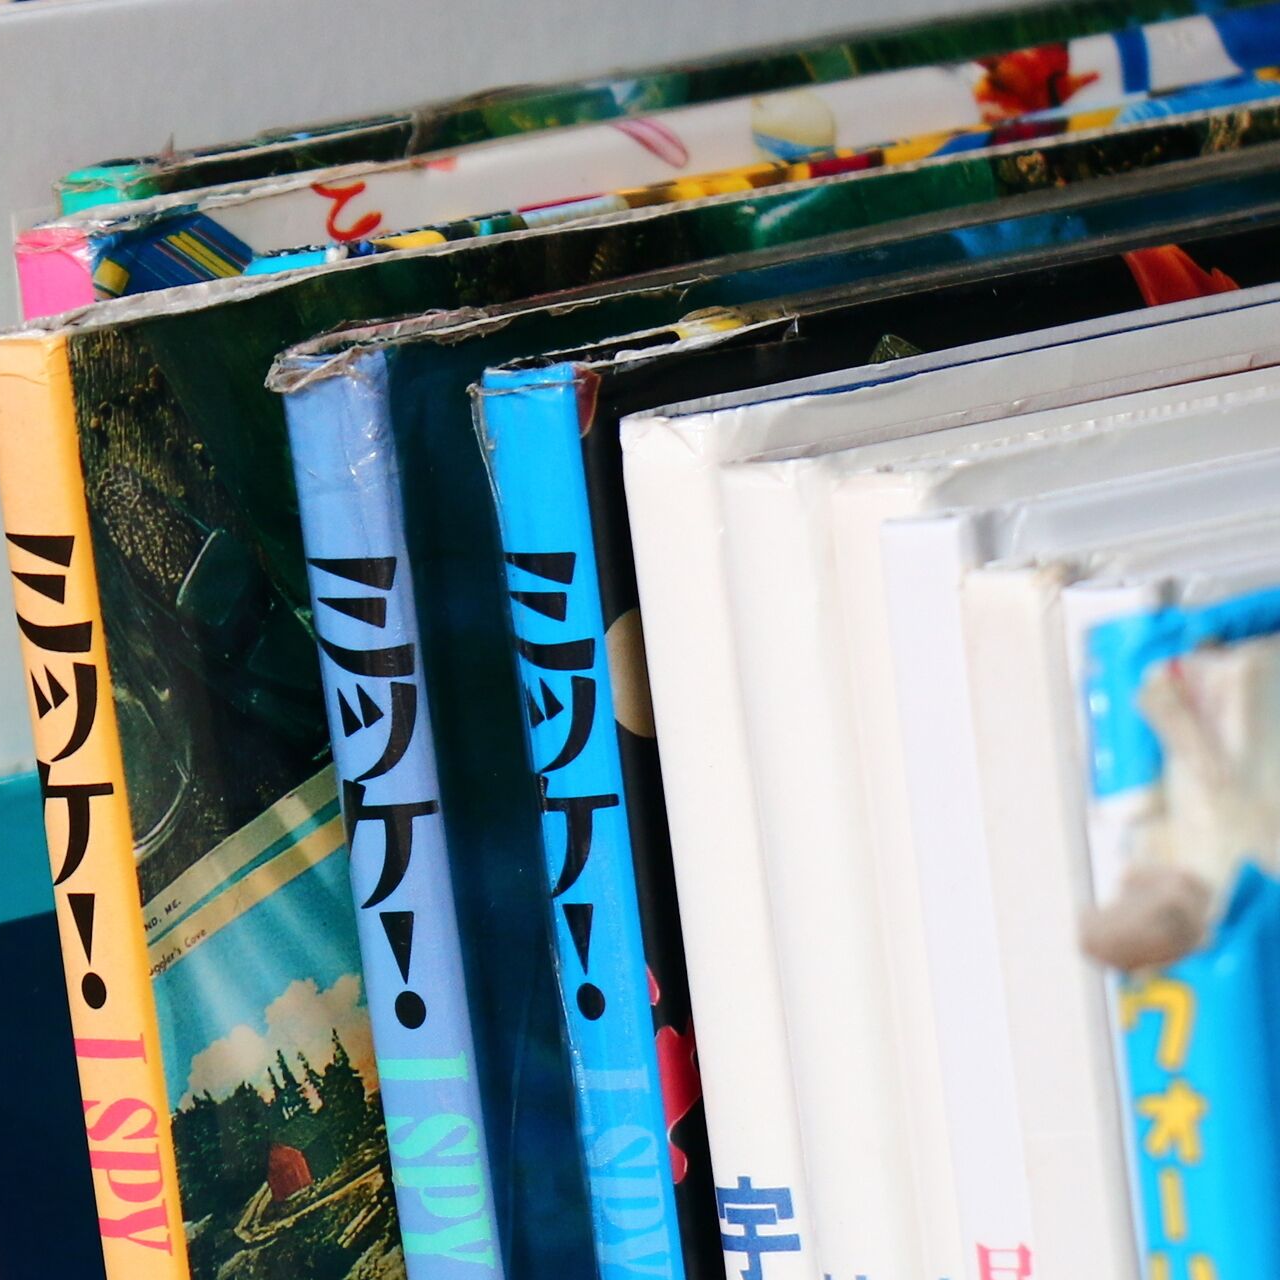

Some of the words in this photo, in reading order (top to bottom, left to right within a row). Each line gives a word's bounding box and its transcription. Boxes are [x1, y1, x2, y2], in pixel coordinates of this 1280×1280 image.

[73, 1032, 148, 1065] I
[377, 1050, 469, 1084] I
[584, 1062, 653, 1093] I
[82, 1097, 174, 1257] SPY
[386, 1112, 495, 1269] SPY
[588, 1123, 673, 1280] SPY
